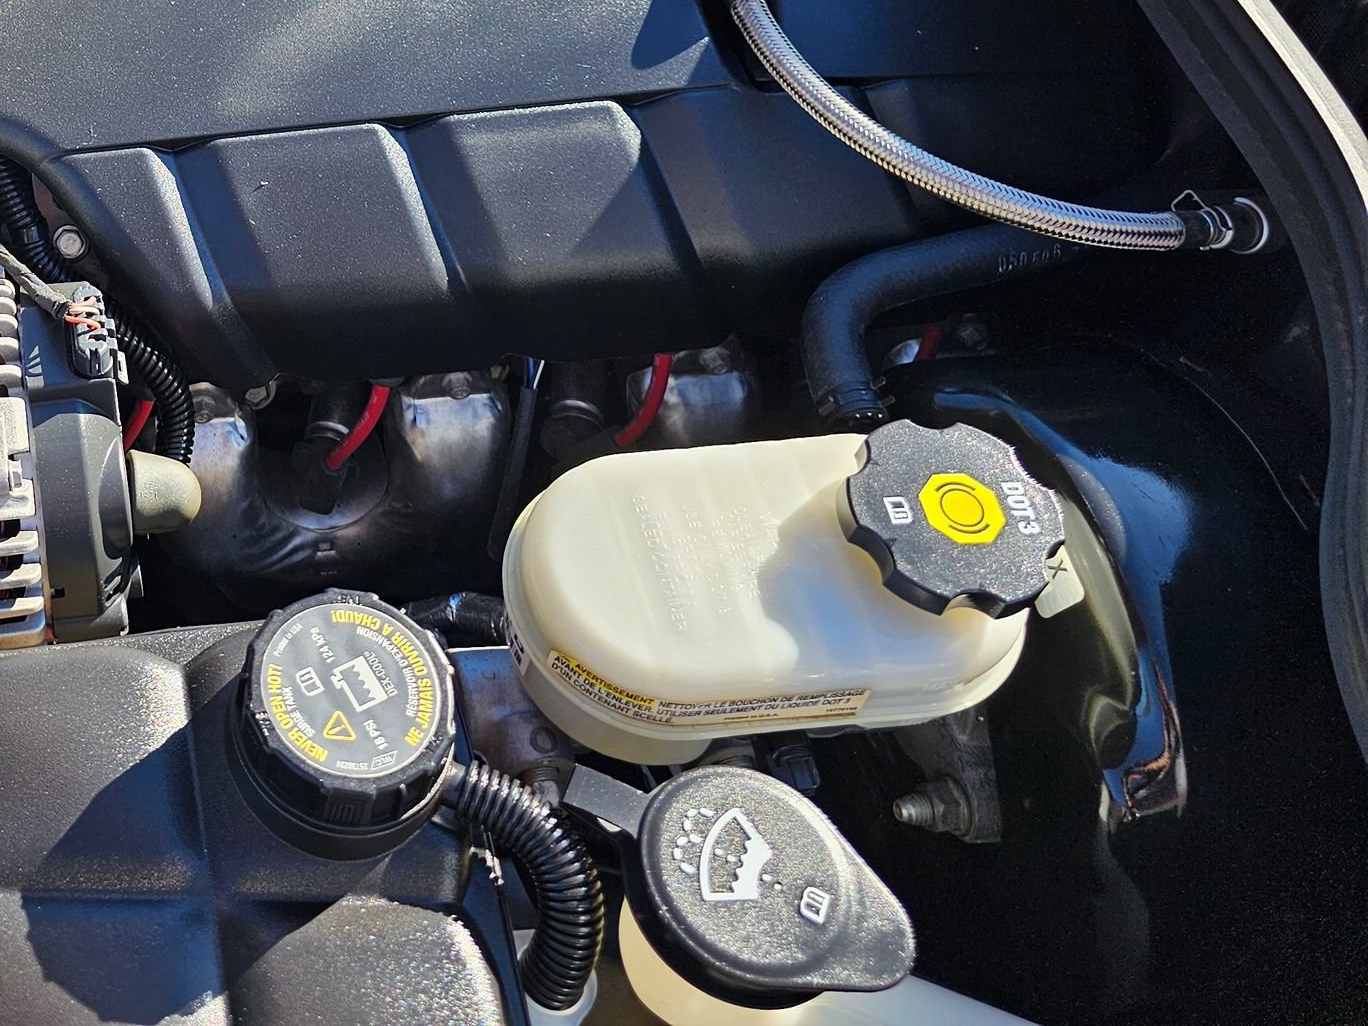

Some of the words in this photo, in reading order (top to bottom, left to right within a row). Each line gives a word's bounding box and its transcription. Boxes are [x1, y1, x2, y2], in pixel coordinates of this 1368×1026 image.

[1001, 482, 1036, 520] DOT
[1018, 520, 1041, 534] 3
[331, 609, 381, 630] CHAUD!
[319, 646, 336, 663] 124
[356, 626, 407, 668] D'EXPANSION
[391, 631, 428, 677] OUVRIR
[267, 664, 282, 693] HOT!
[551, 662, 571, 681] D'UN
[574, 680, 632, 714] CONTENANT
[554, 656, 581, 679] AVANT
[583, 677, 596, 689] DE
[657, 706, 702, 717] UTILISER
[703, 704, 762, 715] SEULEMENT
[781, 699, 819, 709] LIQUIDE
[821, 698, 842, 706] DOT
[576, 663, 655, 705] AVERTISSEMENT
[658, 701, 710, 710] NETTOYER
[729, 697, 777, 707] BOUCHON
[781, 695, 793, 703] DE
[796, 689, 865, 701] REMPLISSAGE
[269, 696, 294, 730] OPEN
[282, 686, 296, 711] TANK
[416, 678, 434, 728] JAMAIS
[290, 710, 316, 738] SURGE
[363, 719, 382, 738] PSI
[404, 727, 425, 747] NE
[288, 727, 328, 762] NEVER
[374, 736, 390, 750] 18
